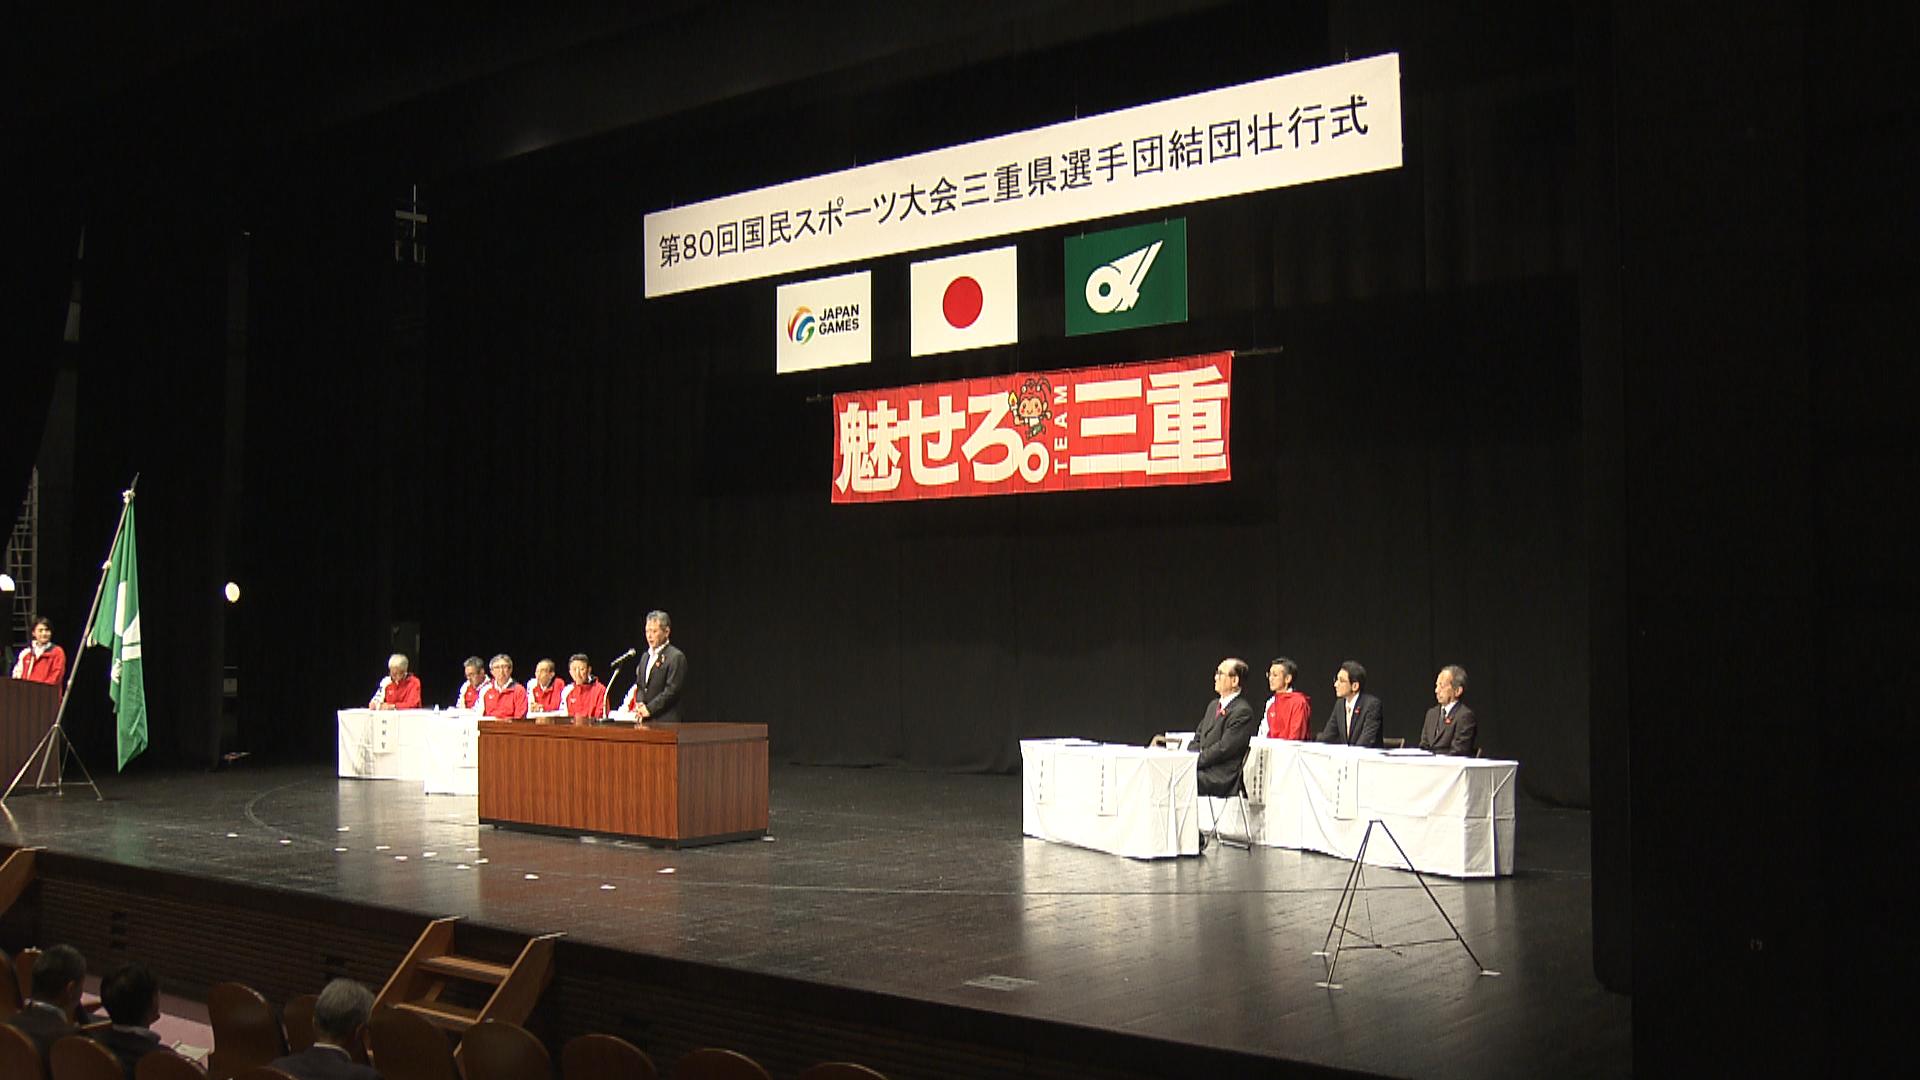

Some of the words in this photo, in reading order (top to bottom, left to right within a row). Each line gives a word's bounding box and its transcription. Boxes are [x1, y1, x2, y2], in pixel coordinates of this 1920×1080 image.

[658, 94, 1369, 269] 第80回国民スポーツ大会三重県選手団結団壮行式
[818, 318, 860, 335] GAMES
[819, 304, 860, 322] JAPAN
[1053, 385, 1069, 475] TEAM
[1069, 366, 1229, 476] 三重
